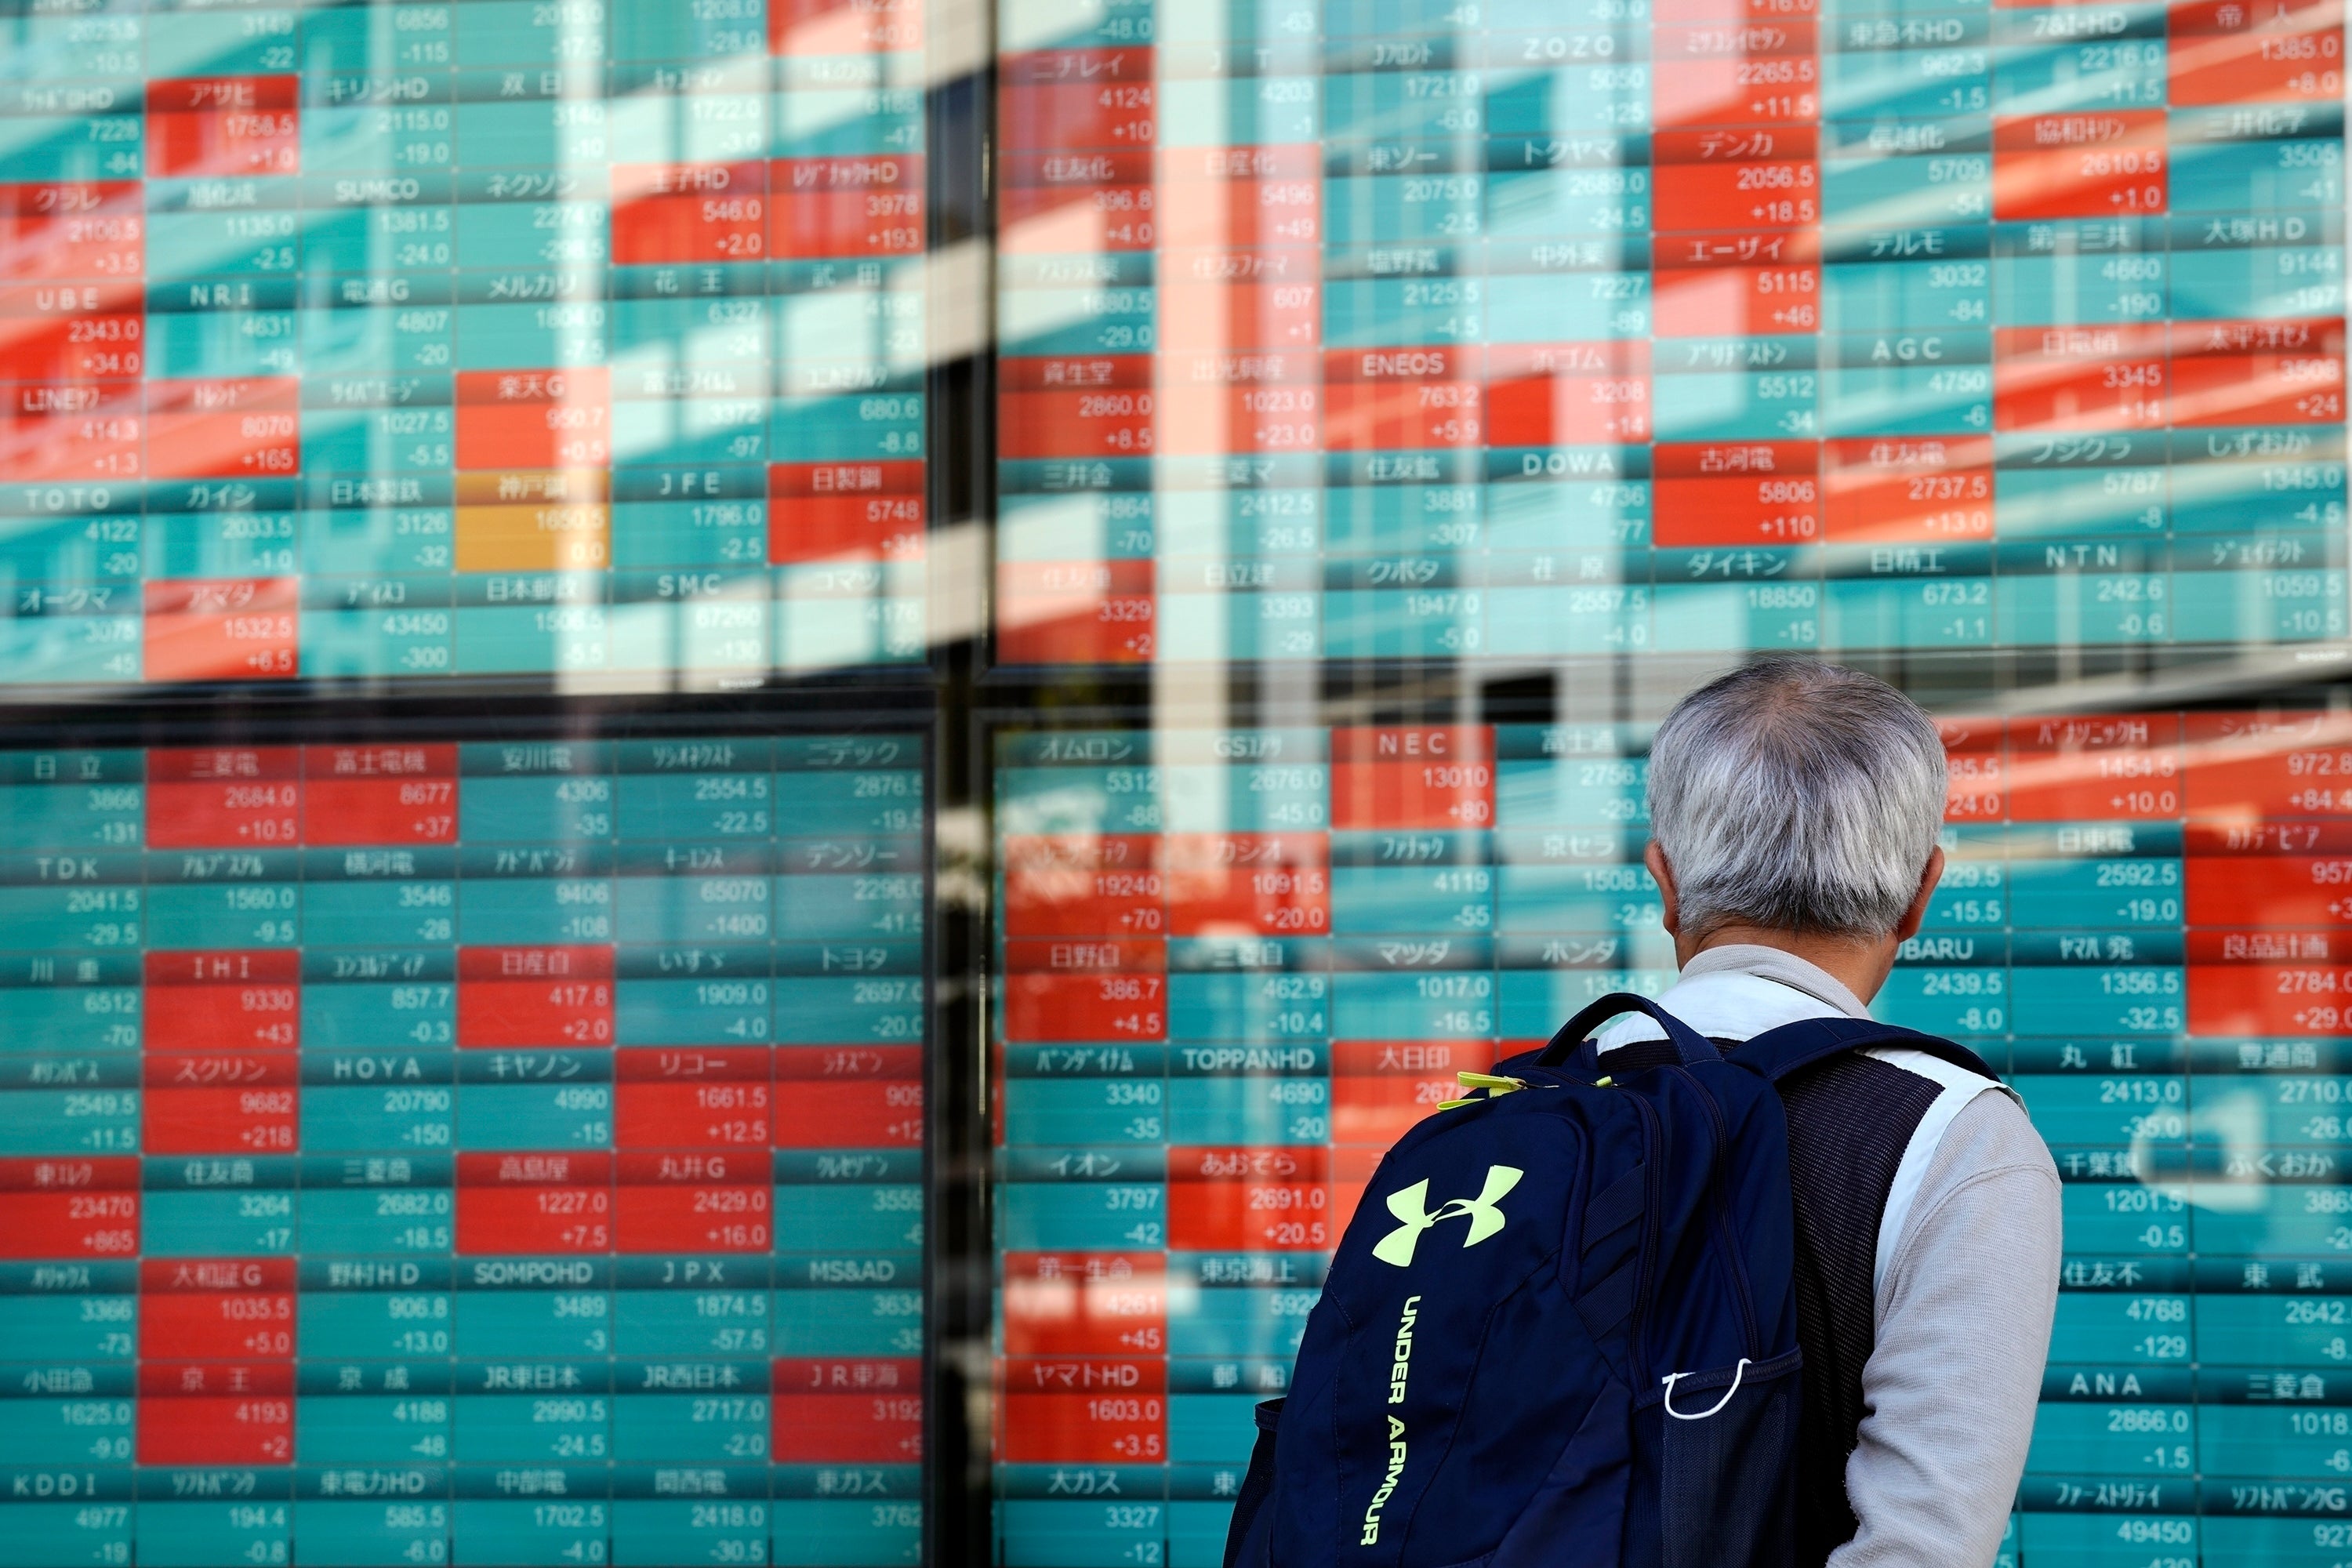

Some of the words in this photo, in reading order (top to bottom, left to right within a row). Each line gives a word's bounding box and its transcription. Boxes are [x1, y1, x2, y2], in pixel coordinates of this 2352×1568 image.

[1099, 88, 1150, 108] 4124
[337, 178, 419, 199] SUMCO
[2110, 186, 2161, 208] +1.0
[868, 227, 919, 249] +193
[1758, 270, 1814, 293] 5115
[1929, 265, 1985, 288] 3032
[69, 320, 139, 342] 2343.0
[1363, 353, 1444, 376] ENEOS
[2103, 365, 2161, 387] 3345
[1909, 476, 1987, 499] 2737.5
[223, 517, 293, 538] 2033.5
[1759, 515, 1815, 536] +110
[383, 614, 448, 635] 43450
[1944, 618, 1985, 637] -1.1
[400, 647, 448, 668] -300
[807, 740, 899, 765] ニデック
[1040, 738, 1132, 760] オムロン
[190, 753, 260, 777] 三菱電
[1423, 767, 1488, 788] 13010
[225, 786, 296, 808] 2684.0
[695, 778, 767, 800] 2554.5
[238, 822, 296, 840] +10.5
[413, 816, 452, 837] +37
[713, 811, 767, 833] -22.5
[2058, 829, 2136, 851] 日東電
[808, 842, 898, 867] デンソー
[2096, 863, 2176, 886] 2592.5
[67, 890, 138, 912] 2041.5
[1941, 900, 2001, 922] -15.5
[2117, 899, 2177, 920] -19.0
[1264, 907, 1324, 928] +20.0
[1613, 903, 1657, 925] -2.5
[253, 920, 294, 942] -9.5
[822, 948, 887, 971] トヨタ
[1051, 944, 1120, 967] 日野自
[1377, 940, 1450, 964] マツダ
[1542, 939, 1617, 963] ホンダ
[697, 984, 767, 1004] 1909.0
[1100, 979, 1160, 1000] 386.7
[1417, 977, 1490, 997] 1017.0
[1922, 972, 2002, 995] 2439.5
[2100, 972, 2179, 994] 1356.5
[85, 993, 137, 1013] 6512
[242, 989, 294, 1011] 9330
[550, 985, 608, 1006] 417.8
[1113, 1013, 1160, 1034] +4.5
[1269, 1012, 1323, 1033] -10.4
[1958, 1008, 2002, 1029] -8.0
[2119, 1007, 2180, 1029] -32.5
[103, 1025, 136, 1046] -70
[256, 1023, 293, 1044] +43
[491, 1054, 580, 1077] キヤノン
[661, 1054, 727, 1074] リコー
[1182, 1048, 1315, 1069] TOPPANHD
[1378, 1047, 1449, 1069] 大日印
[176, 1058, 267, 1081] スクリン
[1106, 1083, 1160, 1105] 3340
[2100, 1080, 2181, 1102] 2413.0
[241, 1126, 292, 1147] +218
[401, 1124, 449, 1145] -150
[572, 1122, 608, 1143] -15
[708, 1120, 766, 1142] +12.5
[659, 1156, 724, 1178] 丸井G
[1051, 1153, 1120, 1176] イオン
[1201, 1152, 1296, 1175] あおぞら
[70, 1196, 134, 1218] 23470
[538, 1192, 607, 1214] 1227.0
[694, 1191, 766, 1212] 2429.0
[1106, 1188, 1160, 1209] 3797
[1250, 1188, 1325, 1209] 2691.0
[256, 1229, 291, 1249] -17
[561, 1225, 607, 1247] +7.5
[707, 1225, 766, 1245] +16.0
[1125, 1222, 1160, 1244] -42
[1265, 1222, 1325, 1243] +20.5
[2139, 1225, 2184, 1247] -0.5
[475, 1262, 593, 1283] SOMPOHD
[810, 1260, 895, 1281] MS&AD
[2063, 1261, 2141, 1286] 住友不
[221, 1298, 290, 1319] 1035.5
[554, 1296, 605, 1317] 3489
[2126, 1299, 2185, 1321] 4768
[393, 1331, 447, 1352] -13.0
[1120, 1328, 1160, 1349] +45
[1388, 1295, 1421, 1404] UNDER
[2134, 1335, 2187, 1358] -129
[484, 1365, 579, 1388] JR東日本
[642, 1365, 739, 1388] JR西日本
[1034, 1364, 1139, 1386] ヤマトHD
[236, 1403, 288, 1423] 4193
[692, 1399, 764, 1421] 2717.0
[1088, 1399, 1160, 1421] 1603.0
[2108, 1410, 2189, 1432] 2866.0
[262, 1436, 288, 1457] +2
[1112, 1434, 1160, 1456] +3.5
[2143, 1446, 2190, 1468] -1.5
[817, 1471, 887, 1494] 東ガス
[1361, 1415, 1406, 1545] ARMOUR
[76, 1507, 128, 1527] 4977
[534, 1505, 604, 1526] 1702.5
[1106, 1506, 1160, 1528] 3327
[2118, 1521, 2192, 1543] 49450
